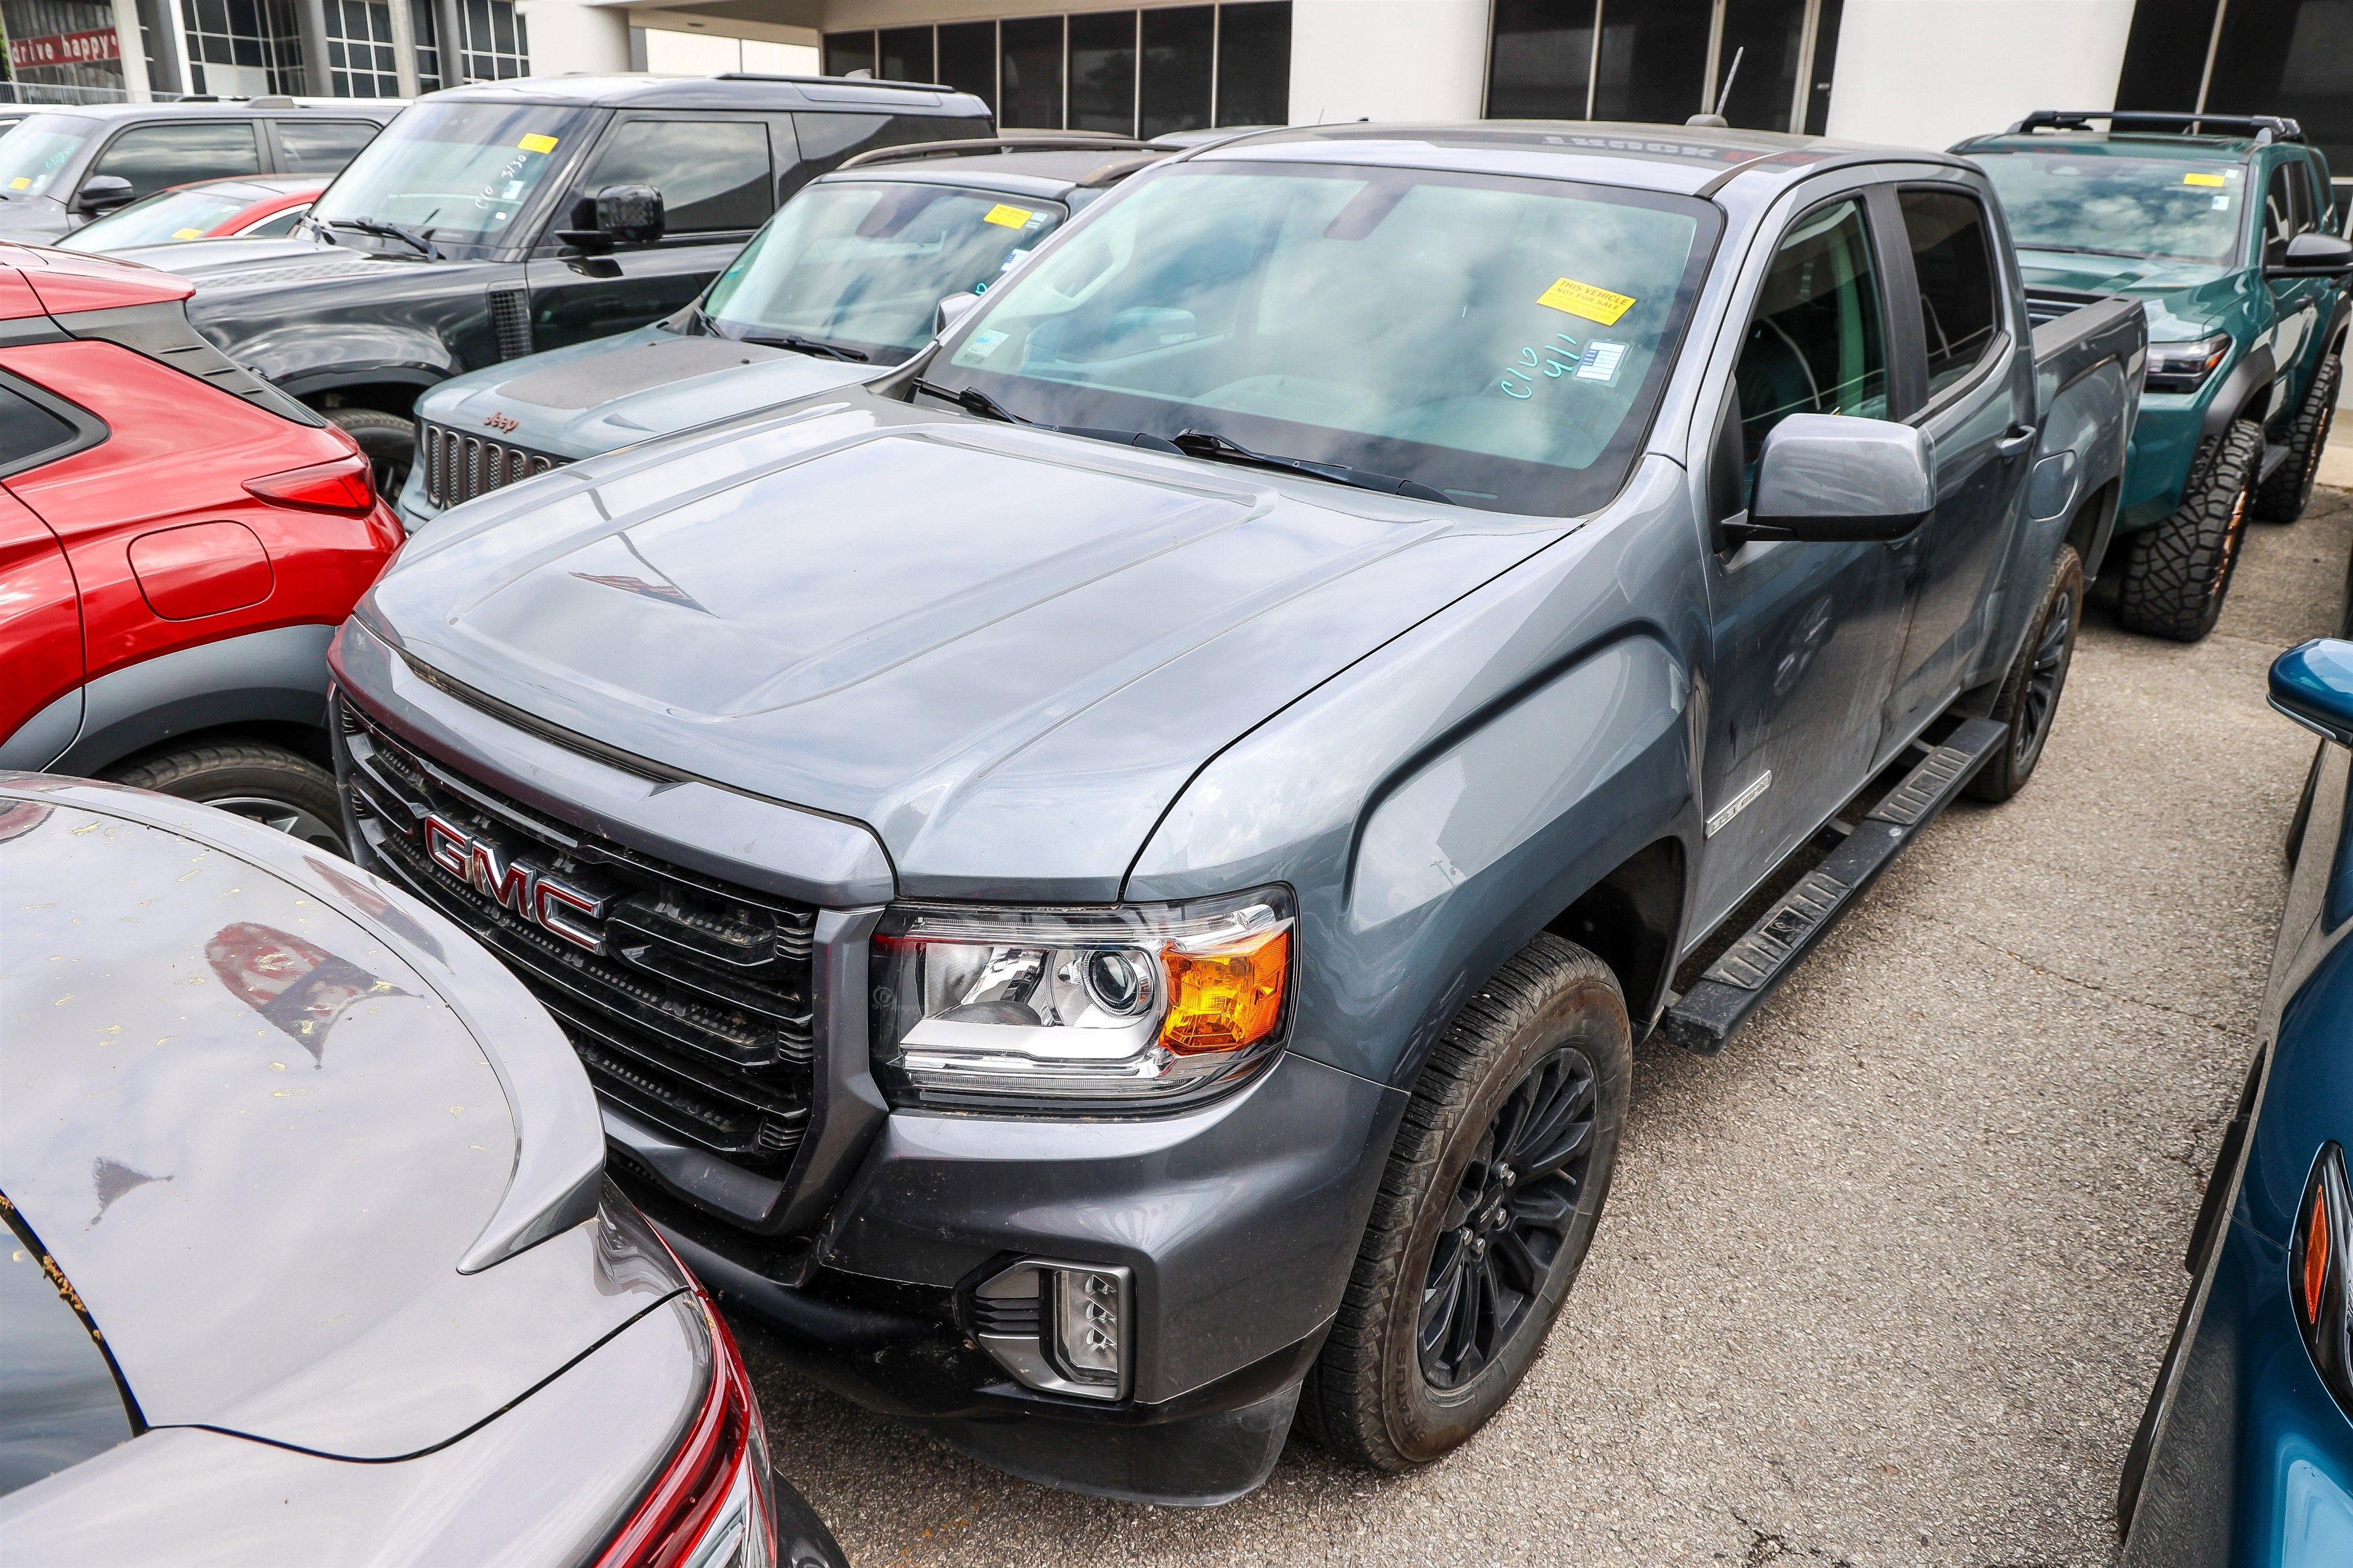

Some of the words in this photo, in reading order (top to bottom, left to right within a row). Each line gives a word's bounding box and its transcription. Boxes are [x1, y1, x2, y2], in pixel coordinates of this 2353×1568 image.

[10, 39, 54, 64] drive
[61, 33, 109, 60] happy
[1556, 288, 1573, 296] NOT
[1575, 293, 1595, 303] FOR
[1597, 300, 1621, 311] SALE
[1559, 280, 1583, 292] THIS
[1585, 287, 1630, 306] VEHICLE
[483, 411, 520, 434] Jeep
[425, 811, 606, 956] GMC
